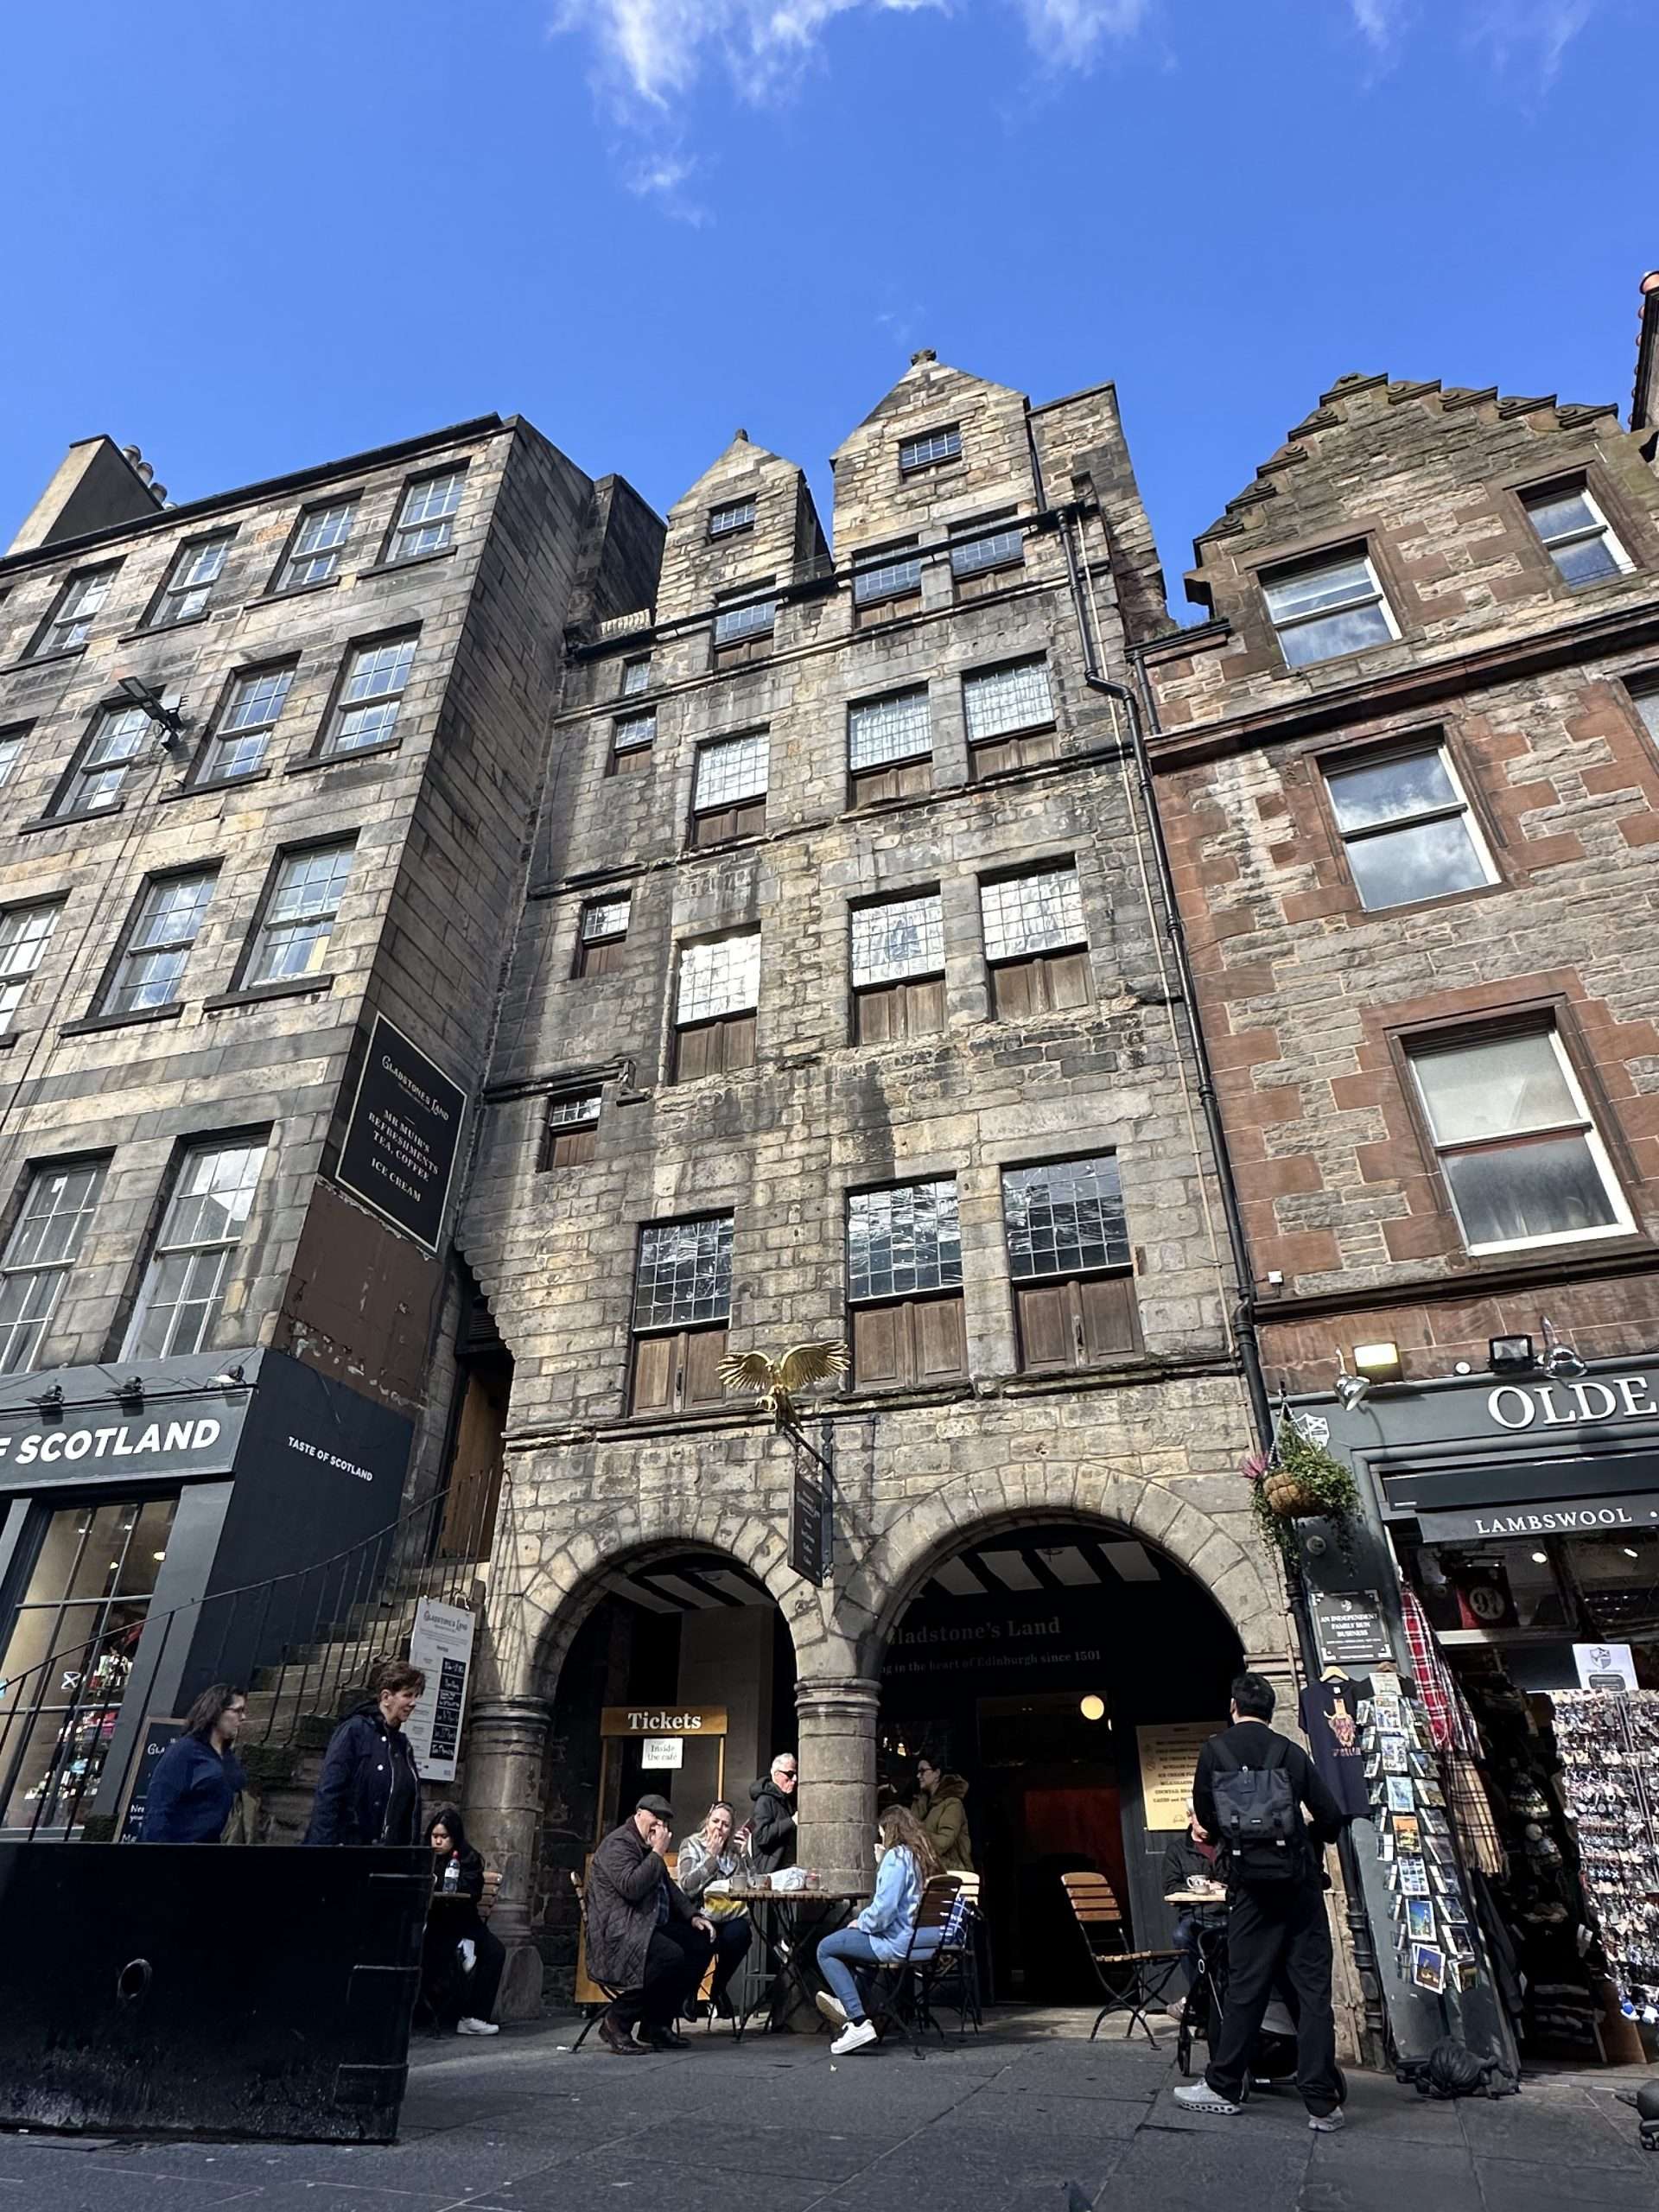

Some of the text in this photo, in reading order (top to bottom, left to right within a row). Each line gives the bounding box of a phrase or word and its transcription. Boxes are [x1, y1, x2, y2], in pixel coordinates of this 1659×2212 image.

[368, 1112, 439, 1175] REFRESHMENTS
[383, 1109, 430, 1154] MR MUIR'S
[371, 1158, 422, 1202] ICE CREAM
[1488, 1376, 1657, 1429] OLDE
[15, 1419, 221, 1465] SCOTLAND
[289, 1436, 373, 1482] TASTE OF SCOTLAND
[1476, 1508, 1632, 1535] LAMBSWOOL
[1007, 1616, 1062, 1637] Land
[977, 1653, 1037, 1668] Edinburgh
[1040, 1652, 1071, 1663] since
[1074, 1650, 1102, 1662] 1501
[628, 1712, 702, 1729] Tickets
